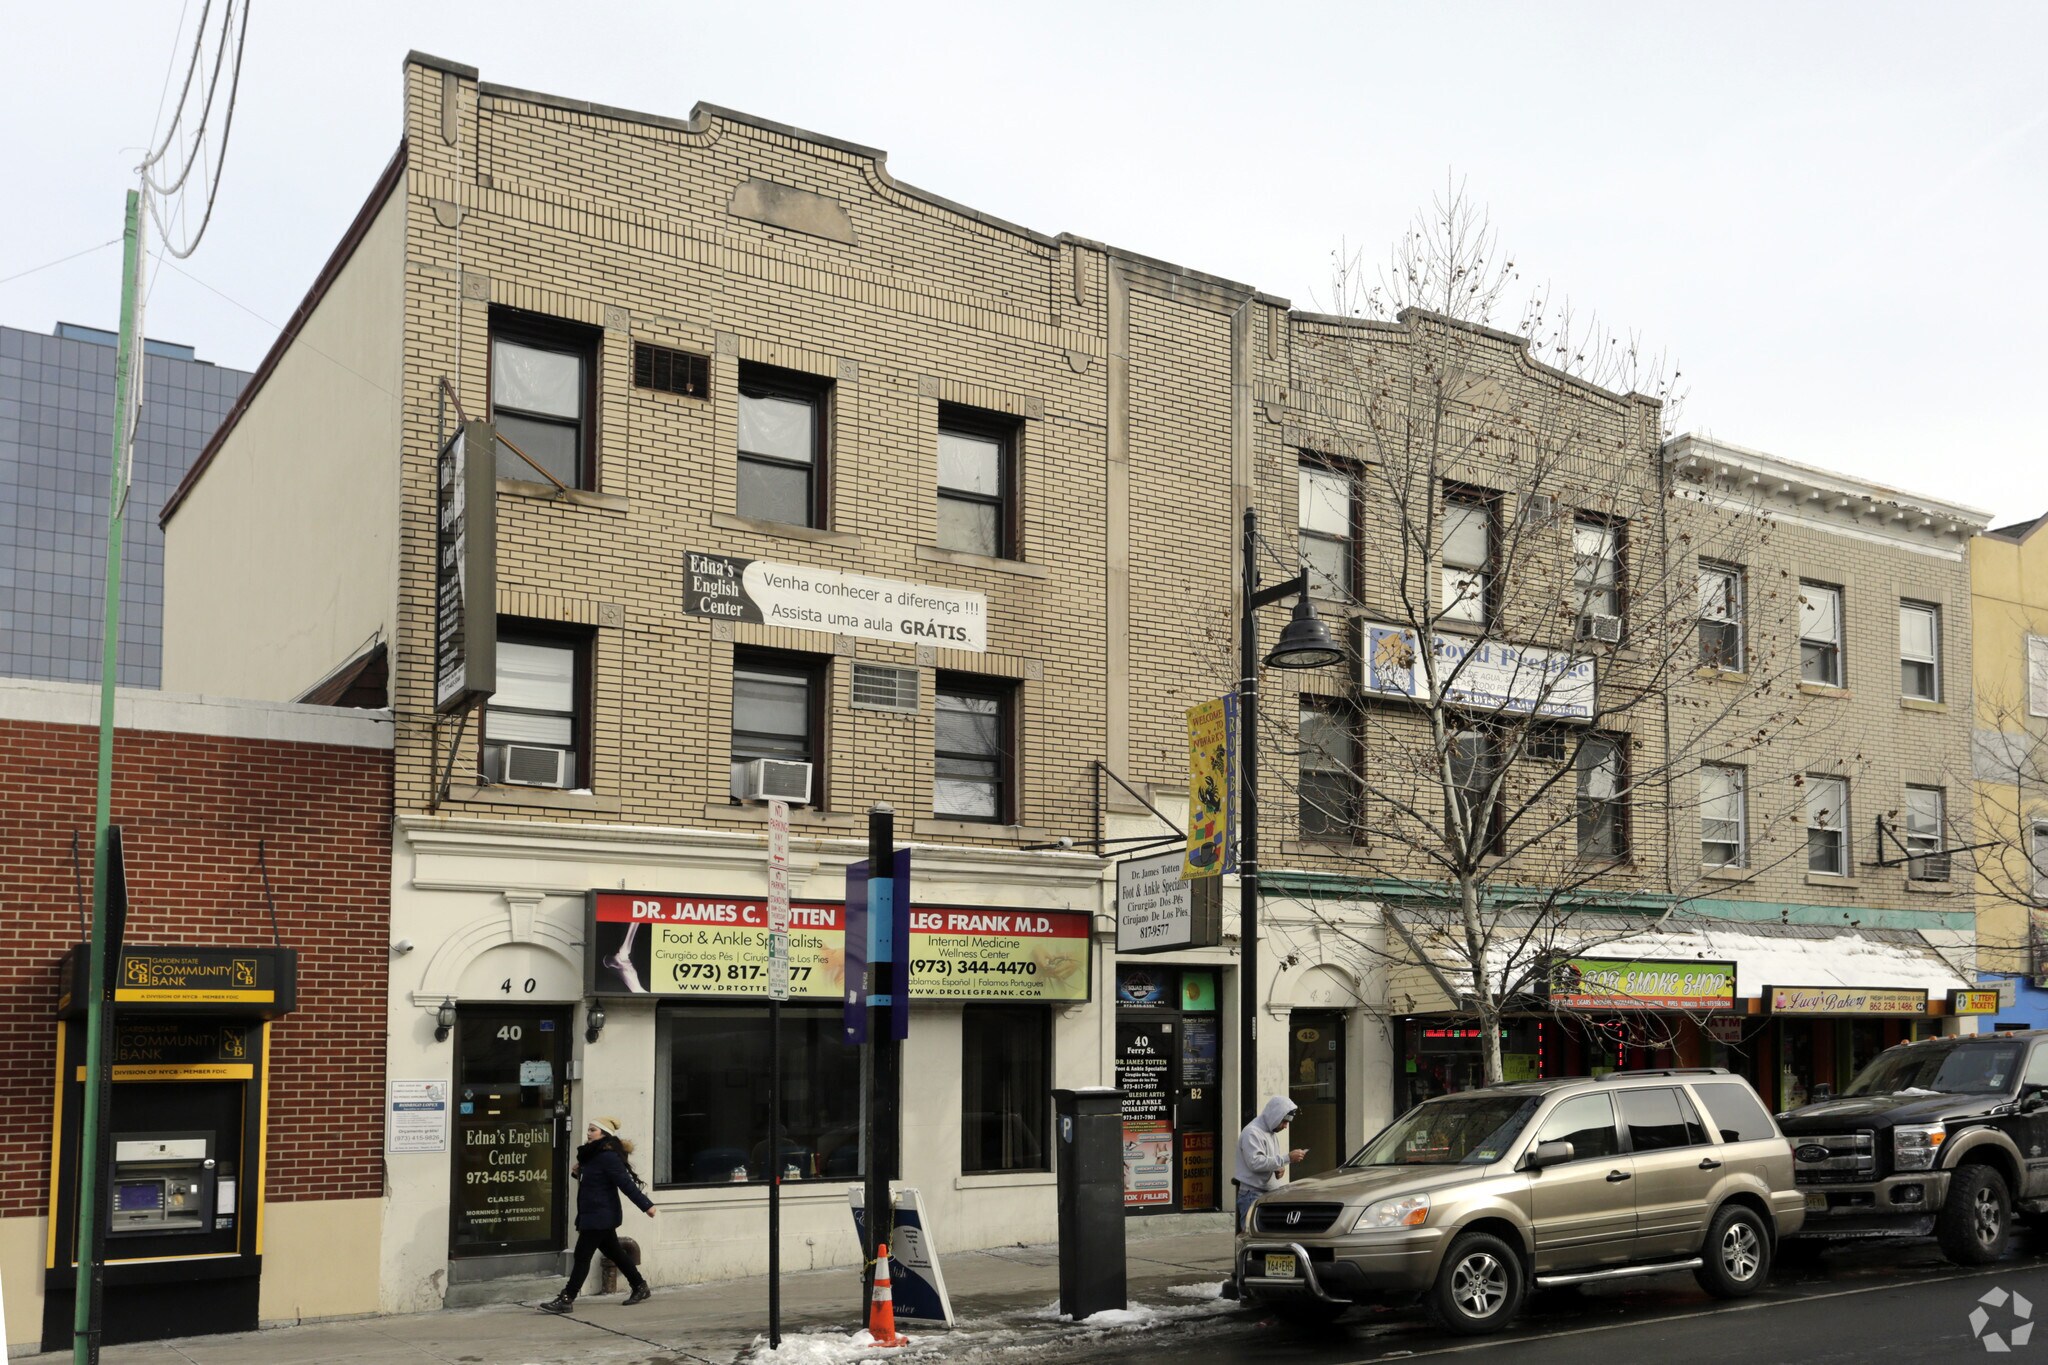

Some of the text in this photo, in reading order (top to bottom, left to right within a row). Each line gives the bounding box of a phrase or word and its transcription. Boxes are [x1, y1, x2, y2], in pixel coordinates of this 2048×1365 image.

[690, 554, 734, 577] Edna's
[693, 575, 739, 598] English
[763, 572, 979, 616] Venha conhecer a diferença !!!
[700, 596, 743, 617] Center
[772, 603, 972, 643] Assista uma aula GRÁTIS.
[1192, 708, 1223, 727] WELCOME
[774, 805, 783, 818] NO
[770, 818, 788, 833] PARKING
[1131, 870, 1141, 880] Dr.
[1142, 867, 1159, 879] James
[1161, 864, 1180, 875] Totten
[1122, 885, 1134, 900] Foot
[1136, 884, 1141, 897] &
[1143, 881, 1160, 896] Ankle
[1160, 897, 1171, 906] Dos
[632, 900, 666, 919] DR.
[671, 903, 737, 922] JAMES
[742, 905, 761, 923] C.
[1122, 910, 1173, 926] Cirujano De Los
[910, 913, 1054, 933] LEG FRANK M.D.
[1140, 923, 1169, 939] 817-9577
[662, 929, 693, 944] Foot
[698, 931, 709, 944] &
[712, 932, 752, 946] Ankle
[756, 934, 823, 949] Spialists
[928, 935, 1020, 949] Internal Medicine
[656, 949, 811, 963] Cirurgião dos Pés Los
[939, 948, 1010, 960] Wellness Center
[151, 965, 232, 976] COMMUNITY
[672, 964, 721, 982] (973)
[910, 960, 1037, 976] (973) 344-4470
[151, 976, 186, 986] BANK
[942, 978, 971, 988] Español
[978, 979, 1009, 987] Falamos
[1584, 970, 1726, 995] BOB SMOKE SHOP
[1788, 991, 1866, 1011] Lucy's Bakery
[1971, 993, 1996, 1002] LOTTERY
[1971, 1001, 1994, 1009] TICKETS
[1710, 1019, 1740, 1028] ATM
[496, 1026, 522, 1041] 40
[1134, 1035, 1149, 1047] 40
[1301, 1031, 1315, 1040] 42
[120, 1035, 218, 1048] COMMUNITY
[120, 1049, 162, 1060] BANK
[1127, 1047, 1145, 1055] Ferry
[1191, 1088, 1202, 1100] B2
[1063, 1117, 1072, 1138] P
[466, 1128, 550, 1148] Edna's English
[1184, 1137, 1213, 1149] LEASE
[488, 1149, 528, 1166] Center
[1184, 1156, 1201, 1166] 1500
[466, 1168, 548, 1185] 973-465-5044
[487, 1195, 525, 1203] CLASSES
[466, 1206, 545, 1216] MORNINGS AFTERNOONS
[470, 1216, 502, 1225] EVENINGS
